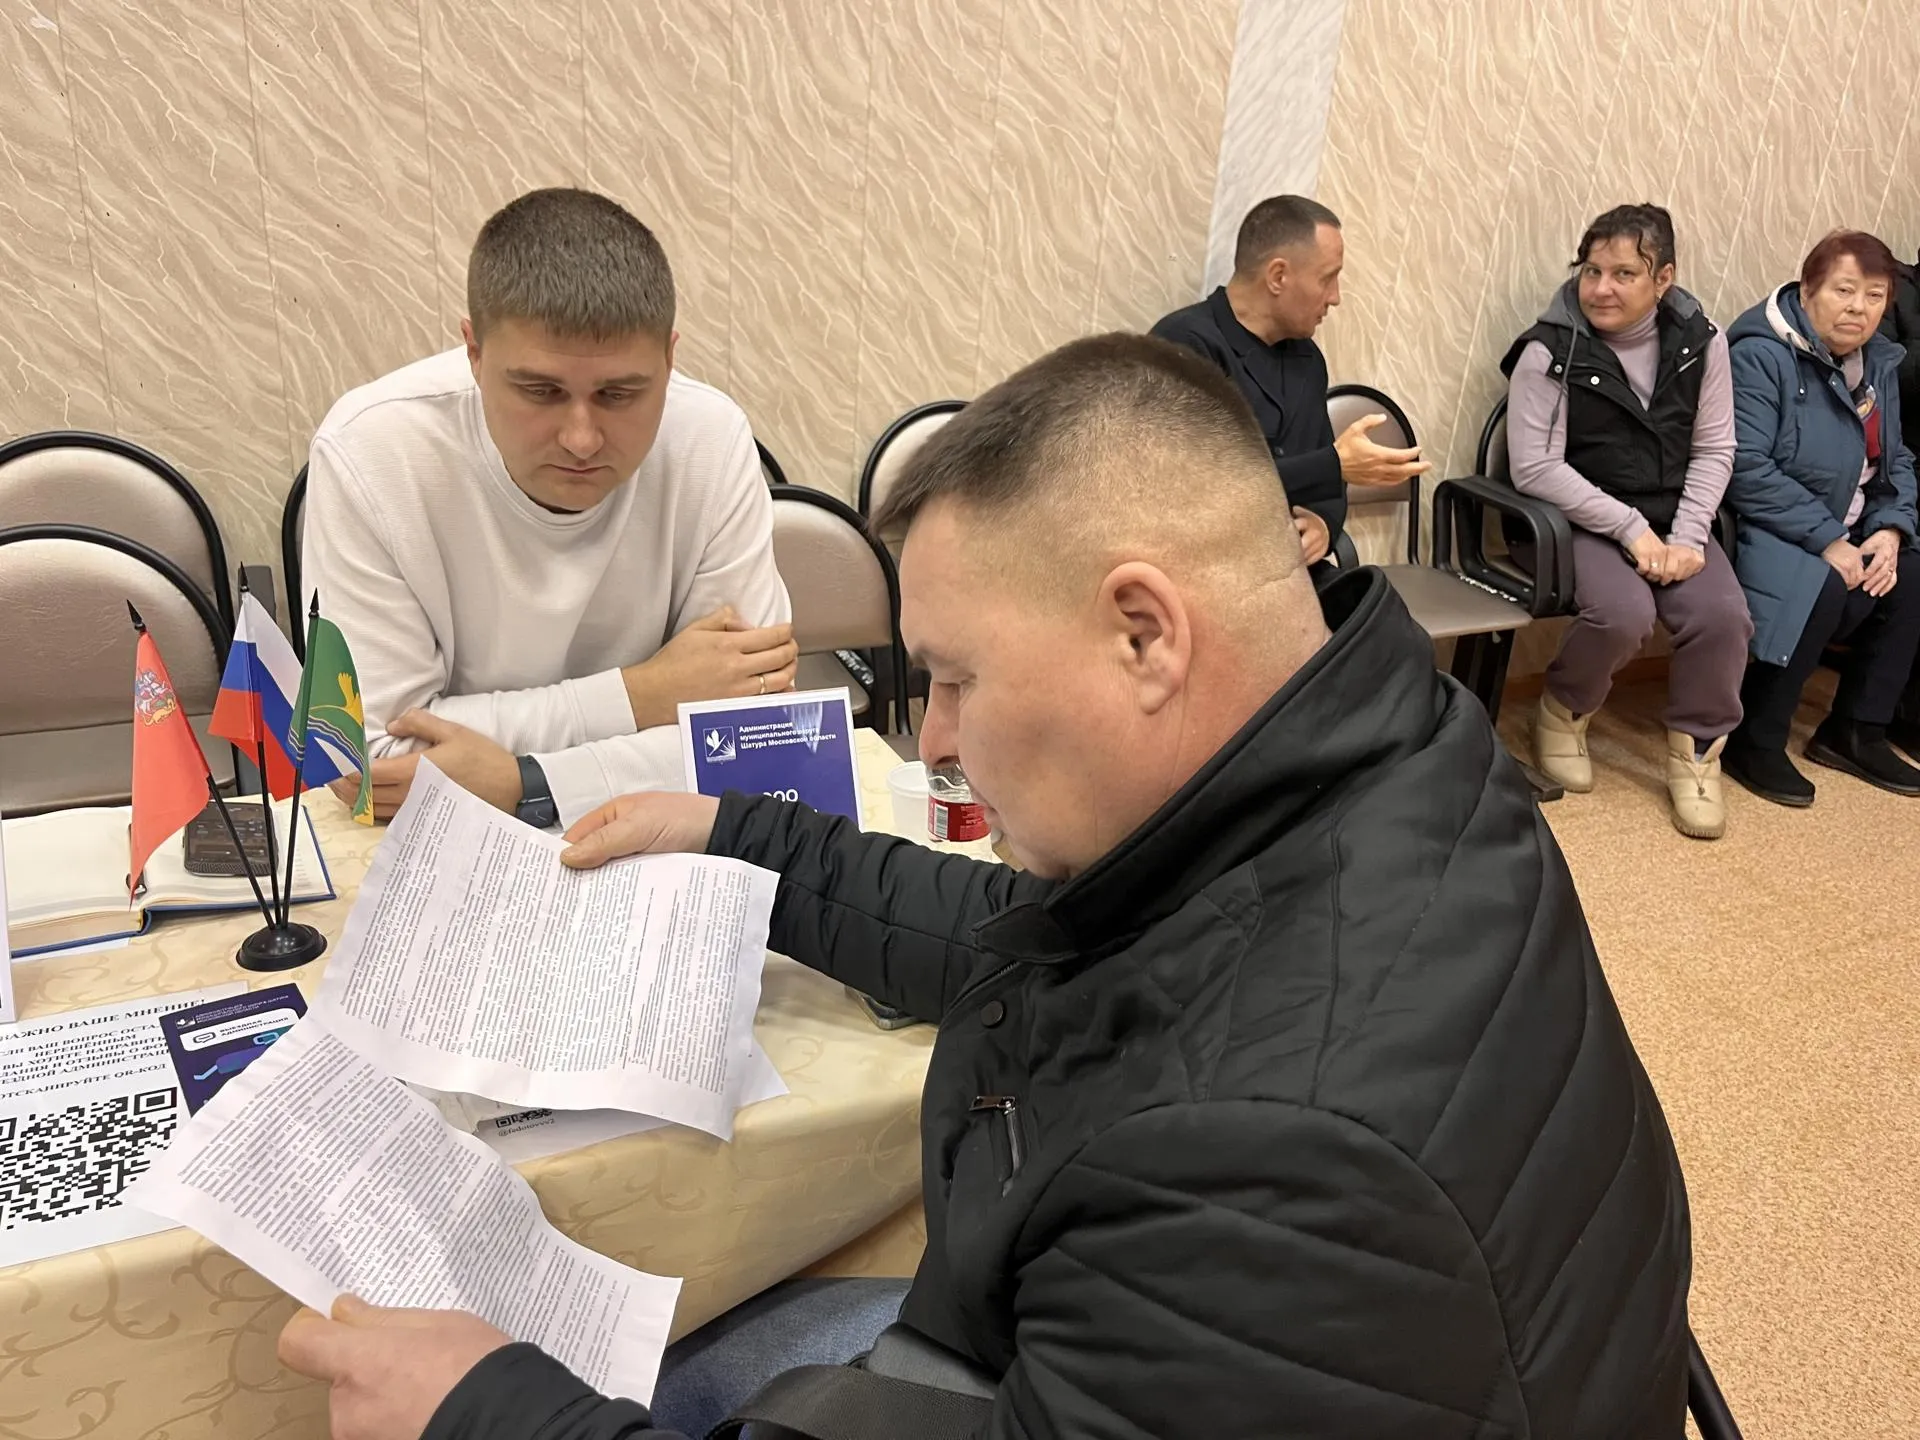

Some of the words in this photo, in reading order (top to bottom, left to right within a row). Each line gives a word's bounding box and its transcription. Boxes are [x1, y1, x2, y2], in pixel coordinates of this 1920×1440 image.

[739, 722, 793, 733] Администрация
[740, 729, 797, 742] муниципального
[741, 740, 767, 750] Шатура
[768, 735, 808, 747] Московской
[68, 1014, 119, 1030] ВАШЕ
[124, 999, 205, 1019] МНЕНИЕ!
[28, 1042, 58, 1053] ВАШ
[62, 1030, 118, 1046] ВОПРОС
[120, 1023, 160, 1035] ОСТА
[35, 1034, 136, 1058] НЕРЕШЁННЫМ
[3, 1062, 23, 1071] ВЫ
[28, 1051, 82, 1066] ХОТИТЕ
[114, 1063, 166, 1079] QR-КОД
